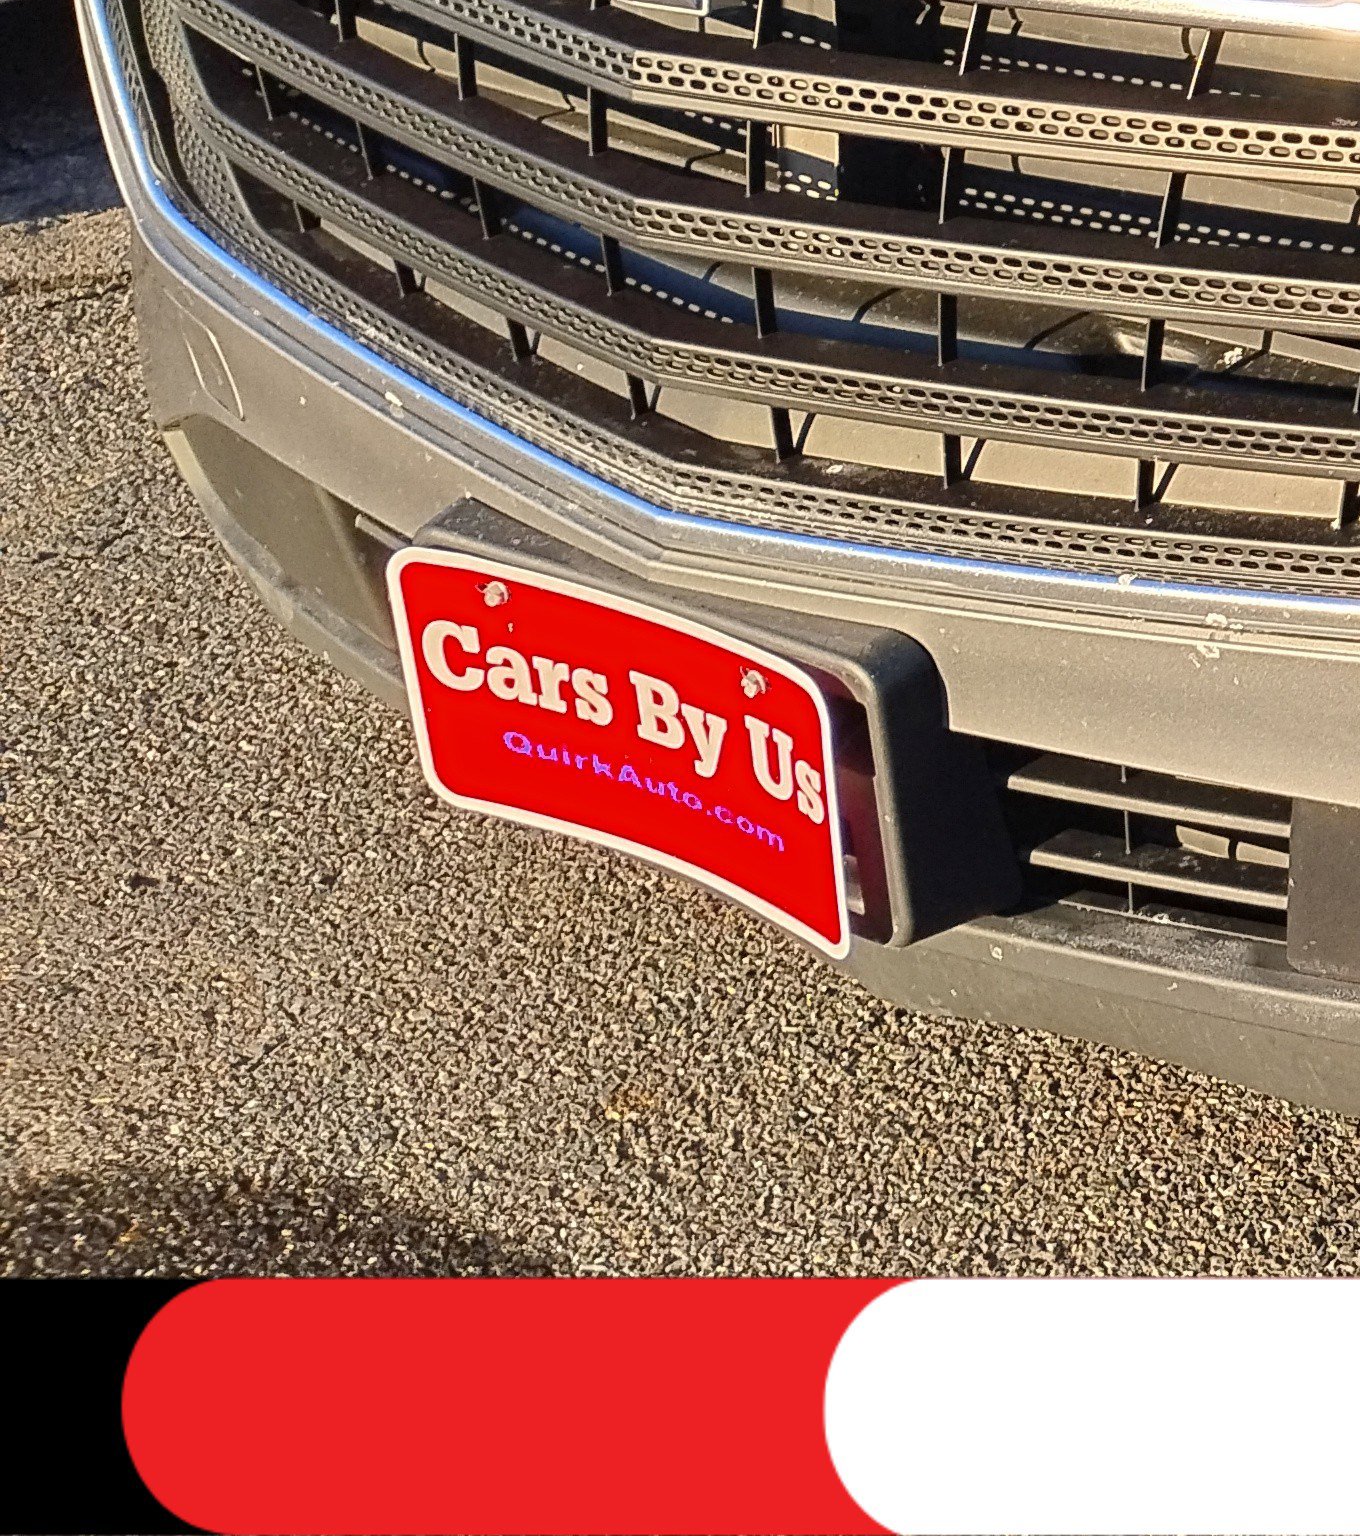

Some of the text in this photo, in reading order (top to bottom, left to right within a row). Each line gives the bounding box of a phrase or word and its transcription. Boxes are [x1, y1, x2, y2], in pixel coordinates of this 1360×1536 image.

[421, 619, 826, 825] Cars By Us
[503, 731, 786, 853] QuirkAuto.com
